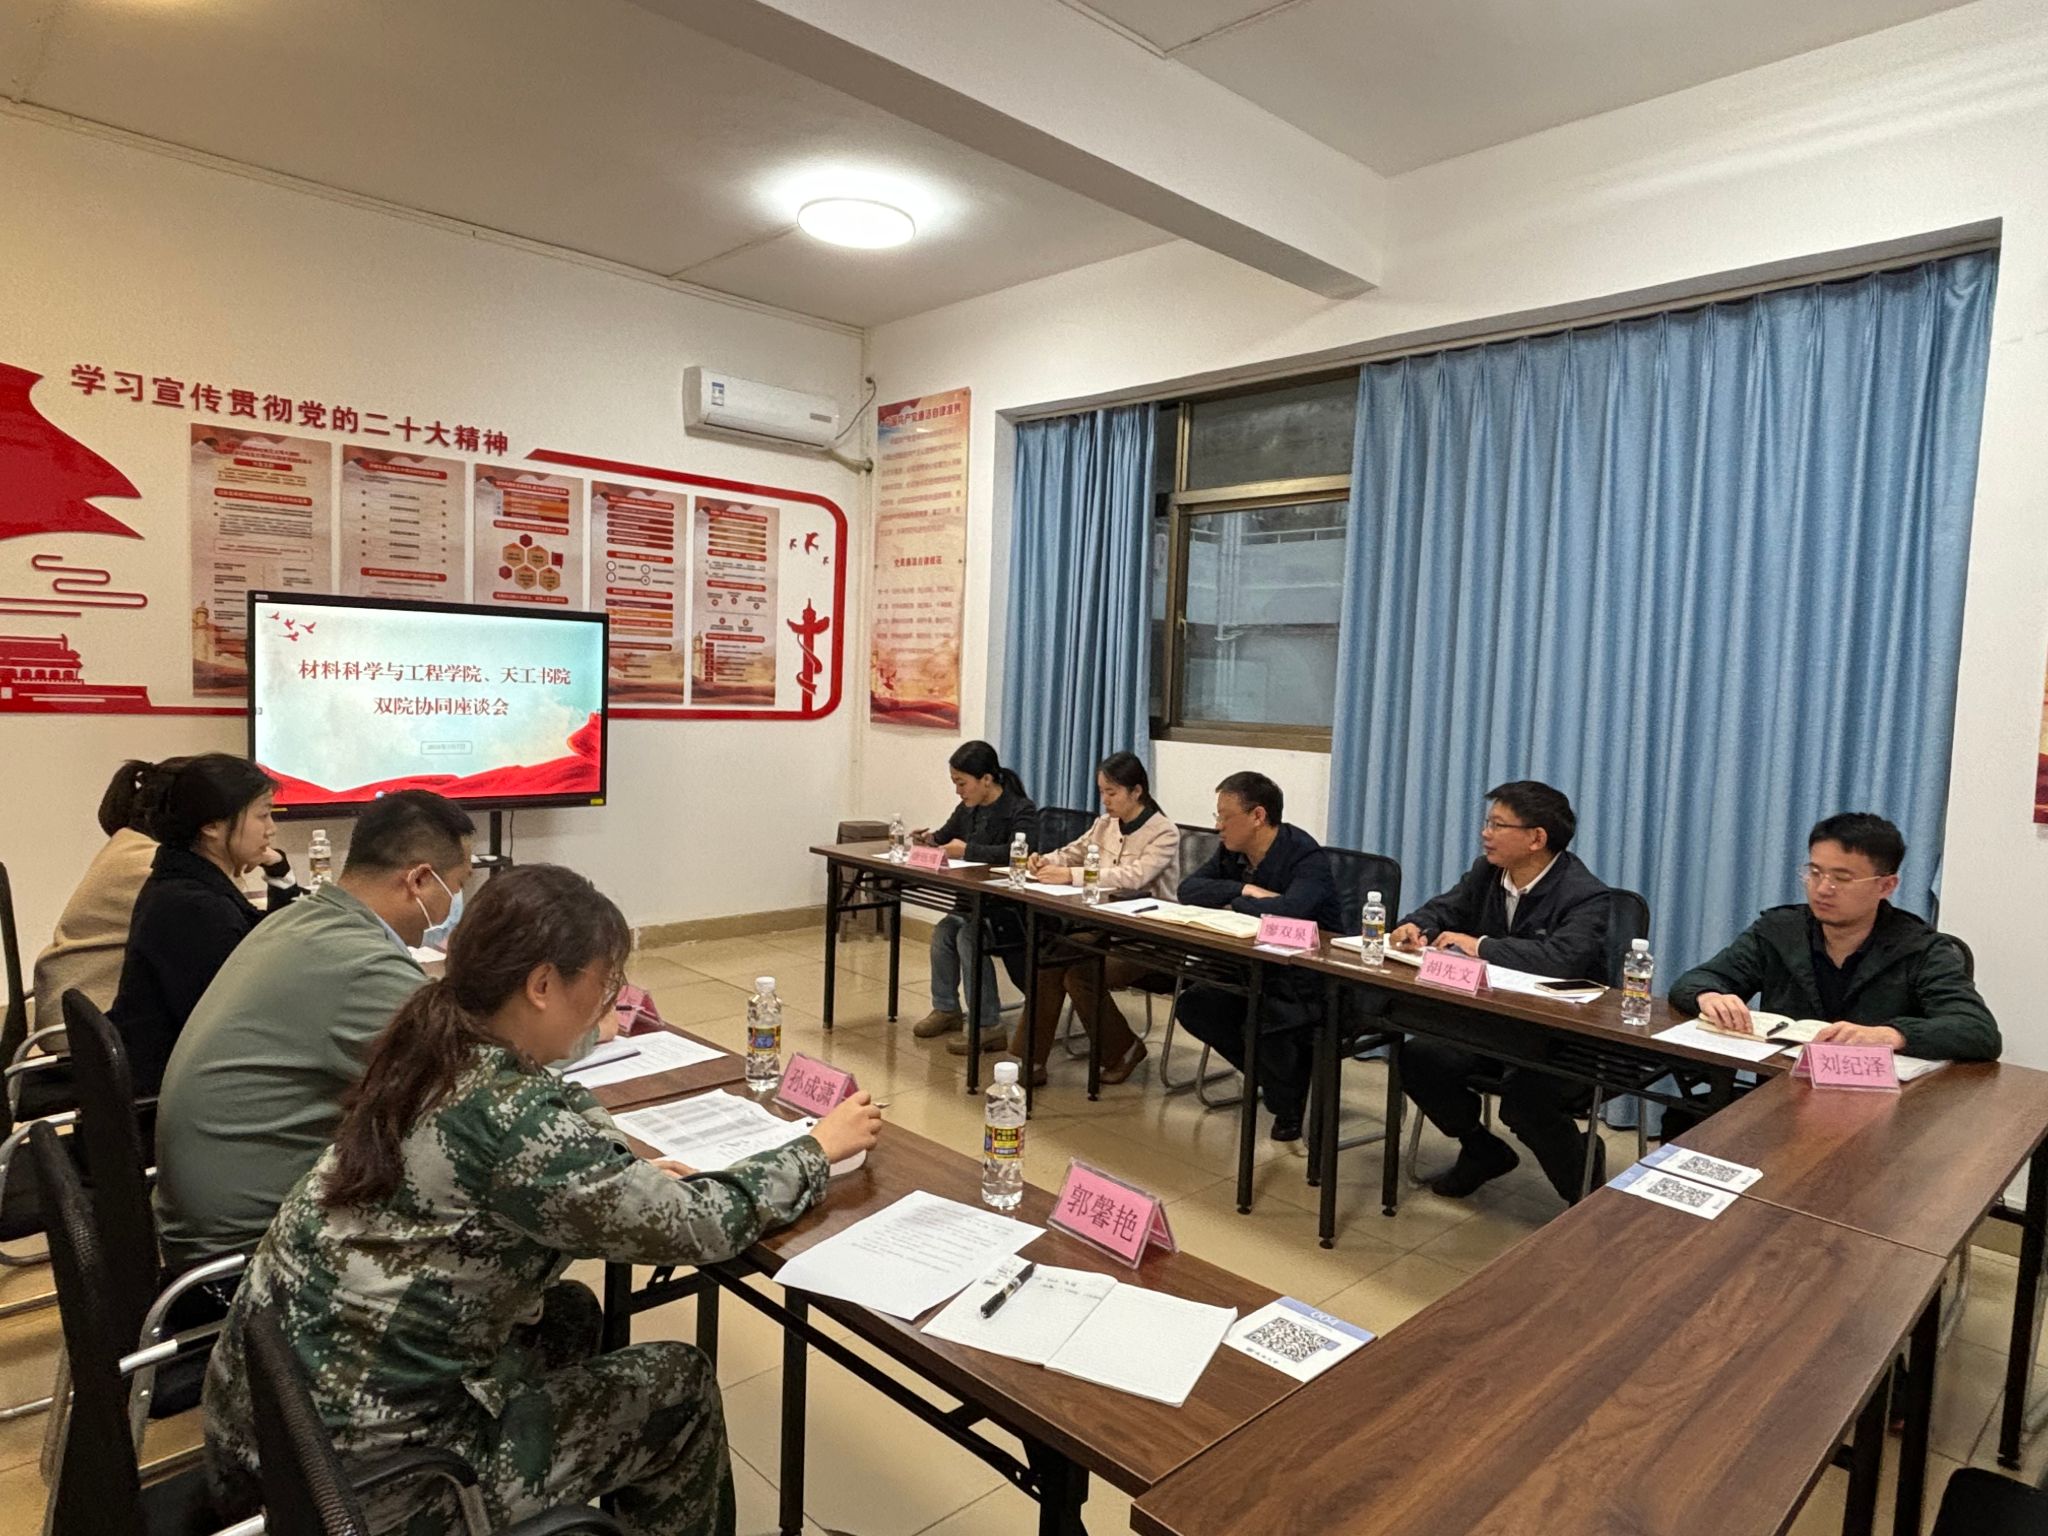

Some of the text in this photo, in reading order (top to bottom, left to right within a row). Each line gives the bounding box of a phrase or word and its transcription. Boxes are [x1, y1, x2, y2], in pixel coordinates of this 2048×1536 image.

[71, 363, 508, 457] 学习宣传贯彻党的二十大精神
[298, 658, 572, 686] 材料科学与工程学院、天工书院
[373, 696, 510, 717] 双院协同座谈会
[1426, 959, 1474, 984] 胡先文
[1820, 1053, 1887, 1078] 刘纪泽
[1067, 1183, 1138, 1242] 郭馨艳
